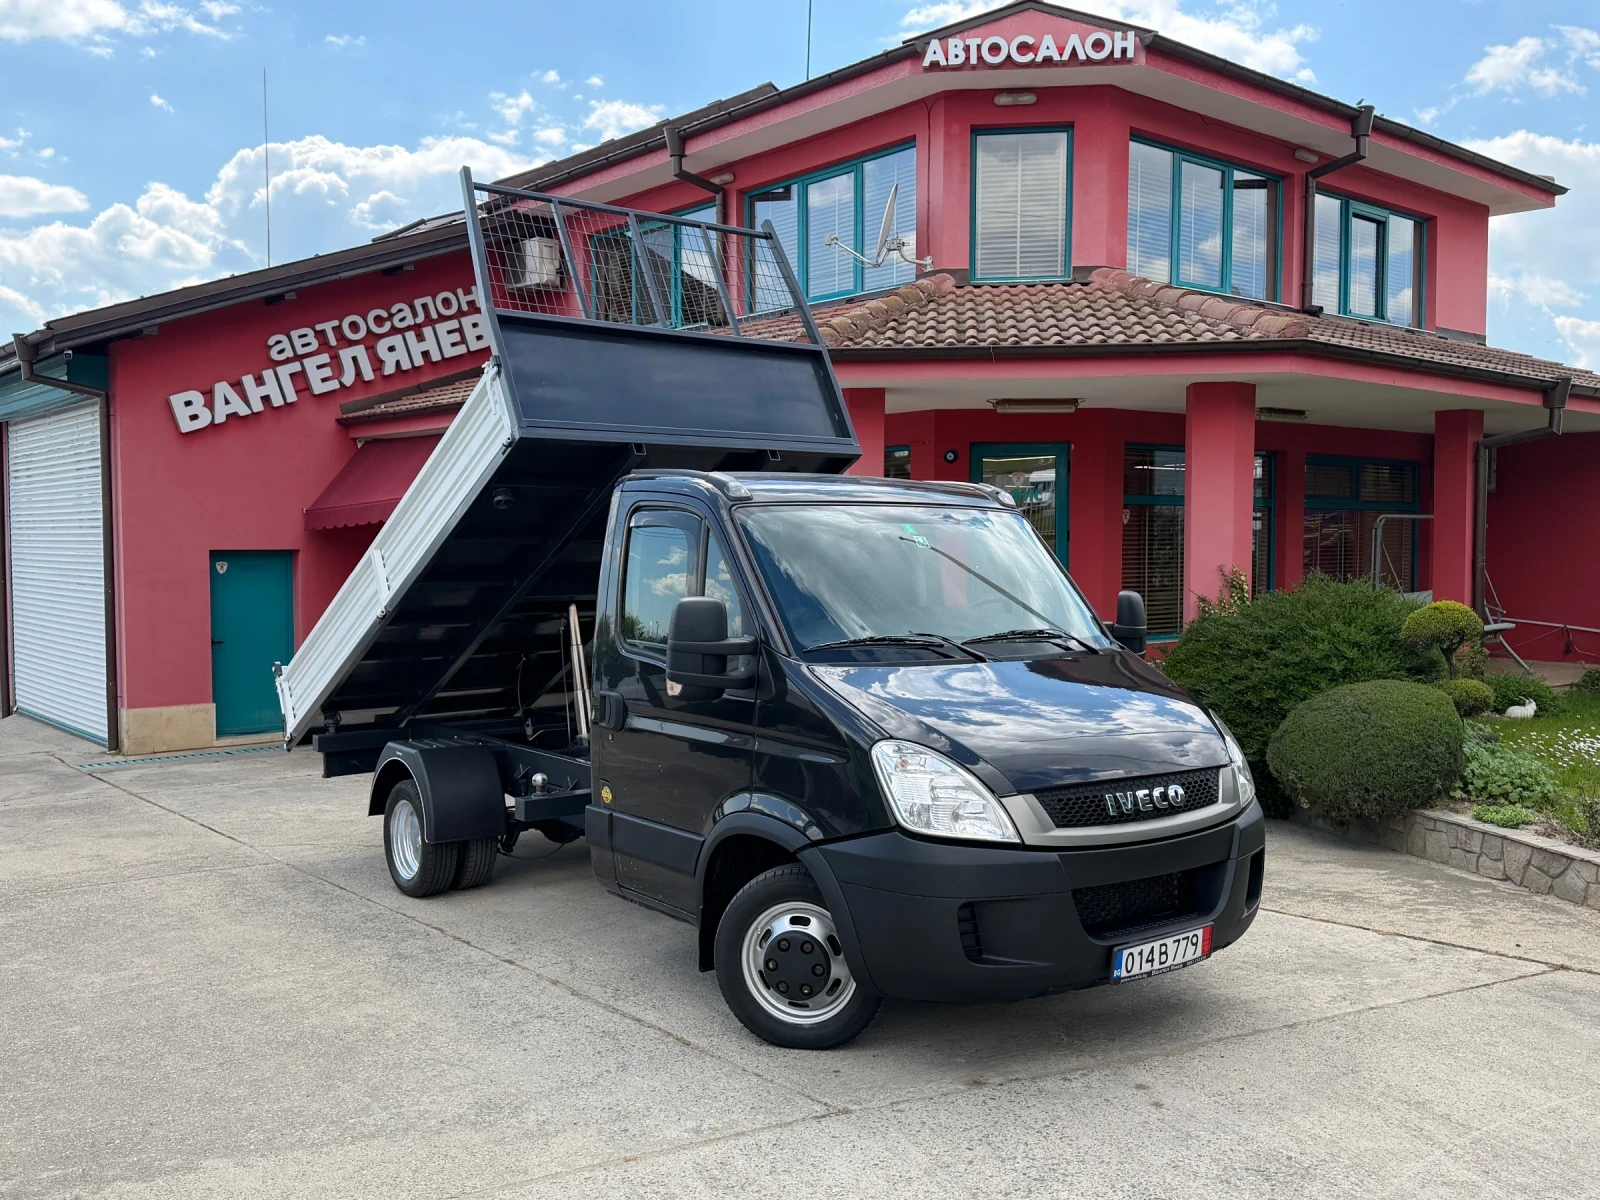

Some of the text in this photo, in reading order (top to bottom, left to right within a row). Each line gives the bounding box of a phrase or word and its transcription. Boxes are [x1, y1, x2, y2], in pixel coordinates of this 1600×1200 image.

[922, 31, 1135, 68] АВТОСАЛОН
[267, 285, 482, 362] автосалон
[168, 313, 491, 434] ВАНГЕЛ ЯНЕВ
[1105, 784, 1186, 816] IVECO
[1113, 969, 1121, 977] BG
